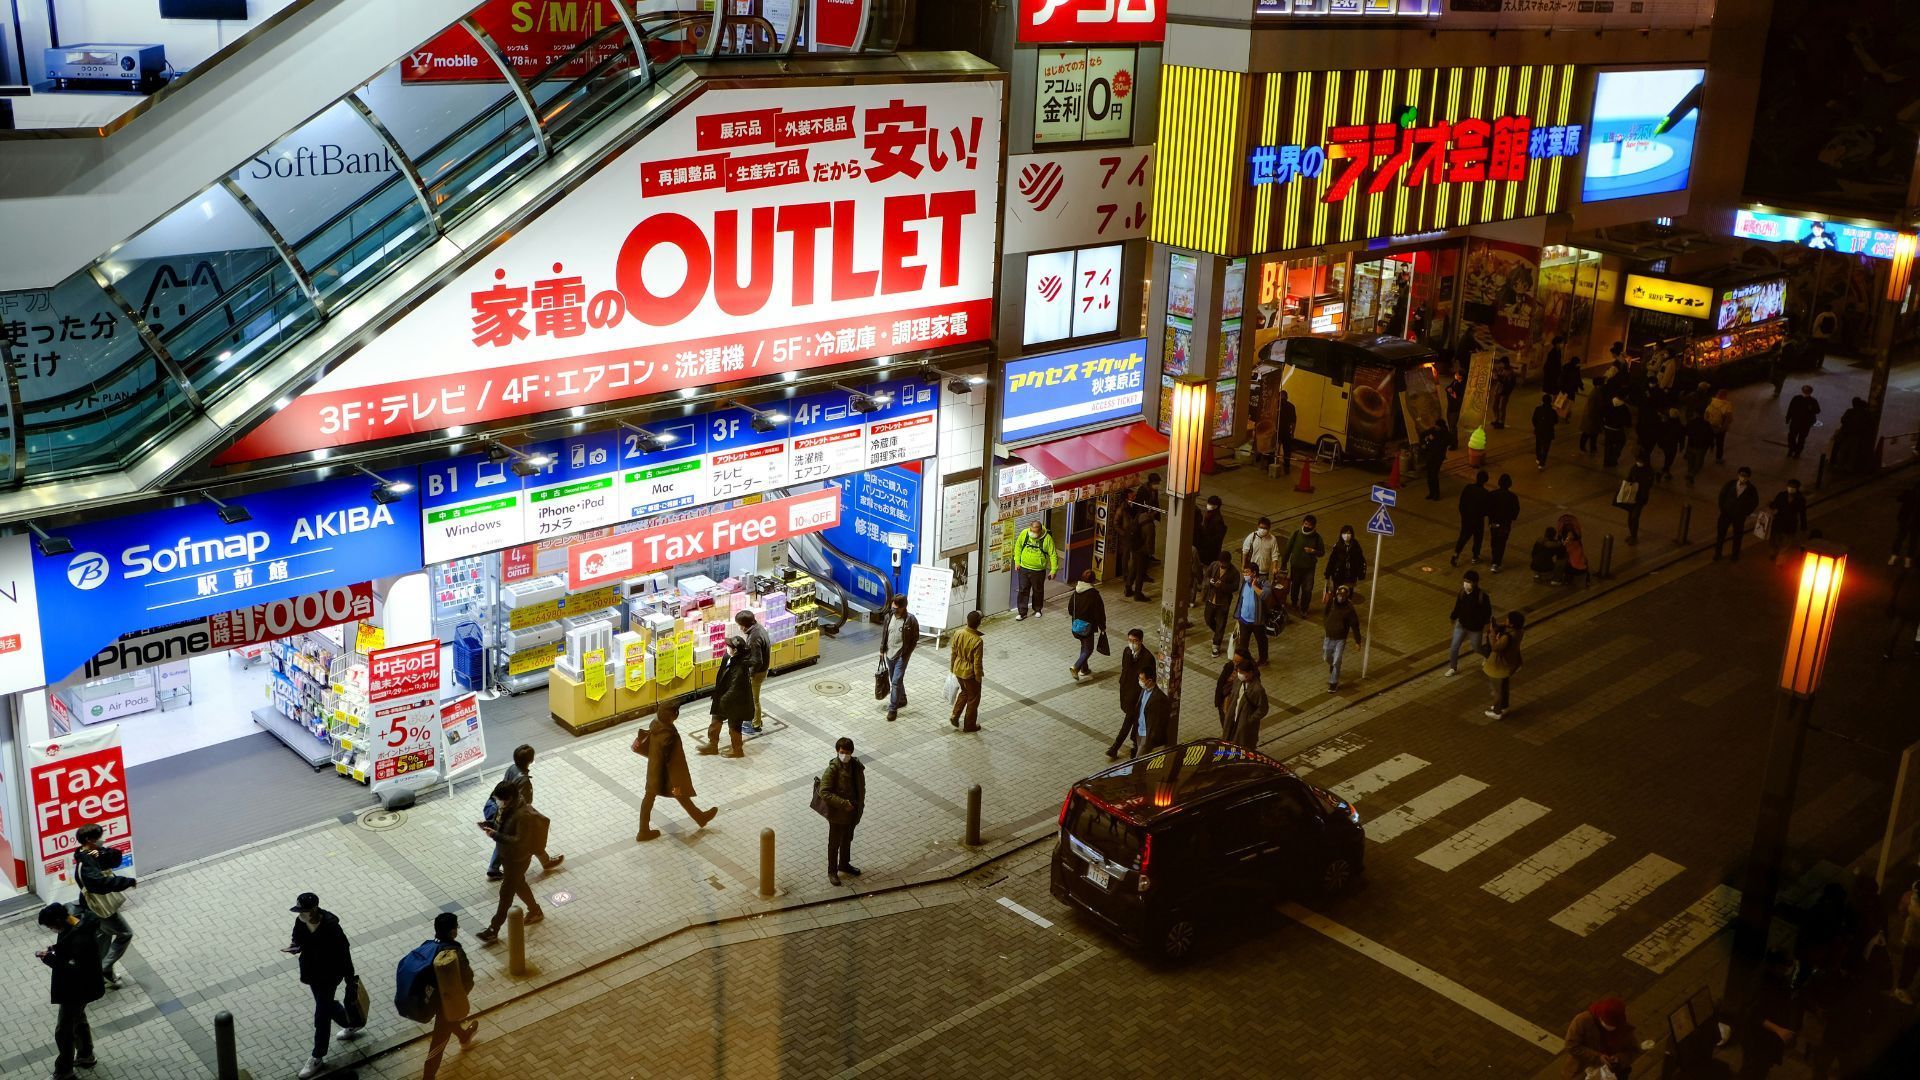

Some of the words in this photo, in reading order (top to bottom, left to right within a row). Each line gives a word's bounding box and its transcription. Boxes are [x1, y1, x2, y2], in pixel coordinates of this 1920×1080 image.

[1044, 60, 1085, 77] はじめての方
[1089, 56, 1103, 67] なら
[1044, 79, 1082, 94] アコムは
[1043, 95, 1082, 123] 金利
[720, 119, 762, 139] 展示品
[784, 115, 849, 138] 外装不良品
[252, 144, 401, 180] SoftBank
[1252, 144, 1325, 186] 世界の
[1321, 107, 1531, 203] ラジオ会館
[1528, 124, 1583, 159] 秋葉原
[658, 163, 717, 187] 再調整品
[736, 158, 800, 183] 生産完了品
[812, 159, 863, 183] だから
[471, 272, 626, 348] 家電の
[616, 190, 977, 327] OUTLET
[1664, 294, 1705, 307] ライオン
[1091, 371, 1142, 396] 秋葉原店
[1091, 399, 1115, 412] ACCESS
[1116, 394, 1138, 406] TICKET
[795, 403, 821, 426] 4F
[713, 419, 740, 442] 3F
[873, 421, 903, 434] アウトレット
[798, 436, 829, 449] アウトレット
[870, 436, 899, 450] 冷蔵庫
[716, 451, 749, 465] アウトレット
[794, 451, 824, 466] 洗濯機
[870, 448, 906, 465] 調理家電
[428, 466, 458, 497] B1
[713, 467, 742, 482] テレビ
[795, 464, 831, 480] エアコン
[652, 482, 674, 496] Mac
[713, 478, 762, 497] レコーダー
[445, 519, 502, 538] Windows
[539, 518, 573, 535] カメラ
[121, 530, 271, 580] Sofmap
[290, 504, 395, 544] AKIBA
[643, 531, 704, 564] Tax
[712, 513, 778, 549] Free
[511, 548, 526, 563] 4F
[197, 561, 289, 595] 駅前館
[507, 566, 530, 579] OUTLET
[85, 629, 210, 680] iPhone
[373, 652, 436, 678] 中古の日
[370, 670, 439, 692] 歳末スペシャル
[108, 703, 123, 713] Air
[125, 697, 150, 708] Pods
[377, 741, 432, 760] ポイントサービス
[38, 760, 119, 799] Tax
[38, 788, 126, 832] Free
